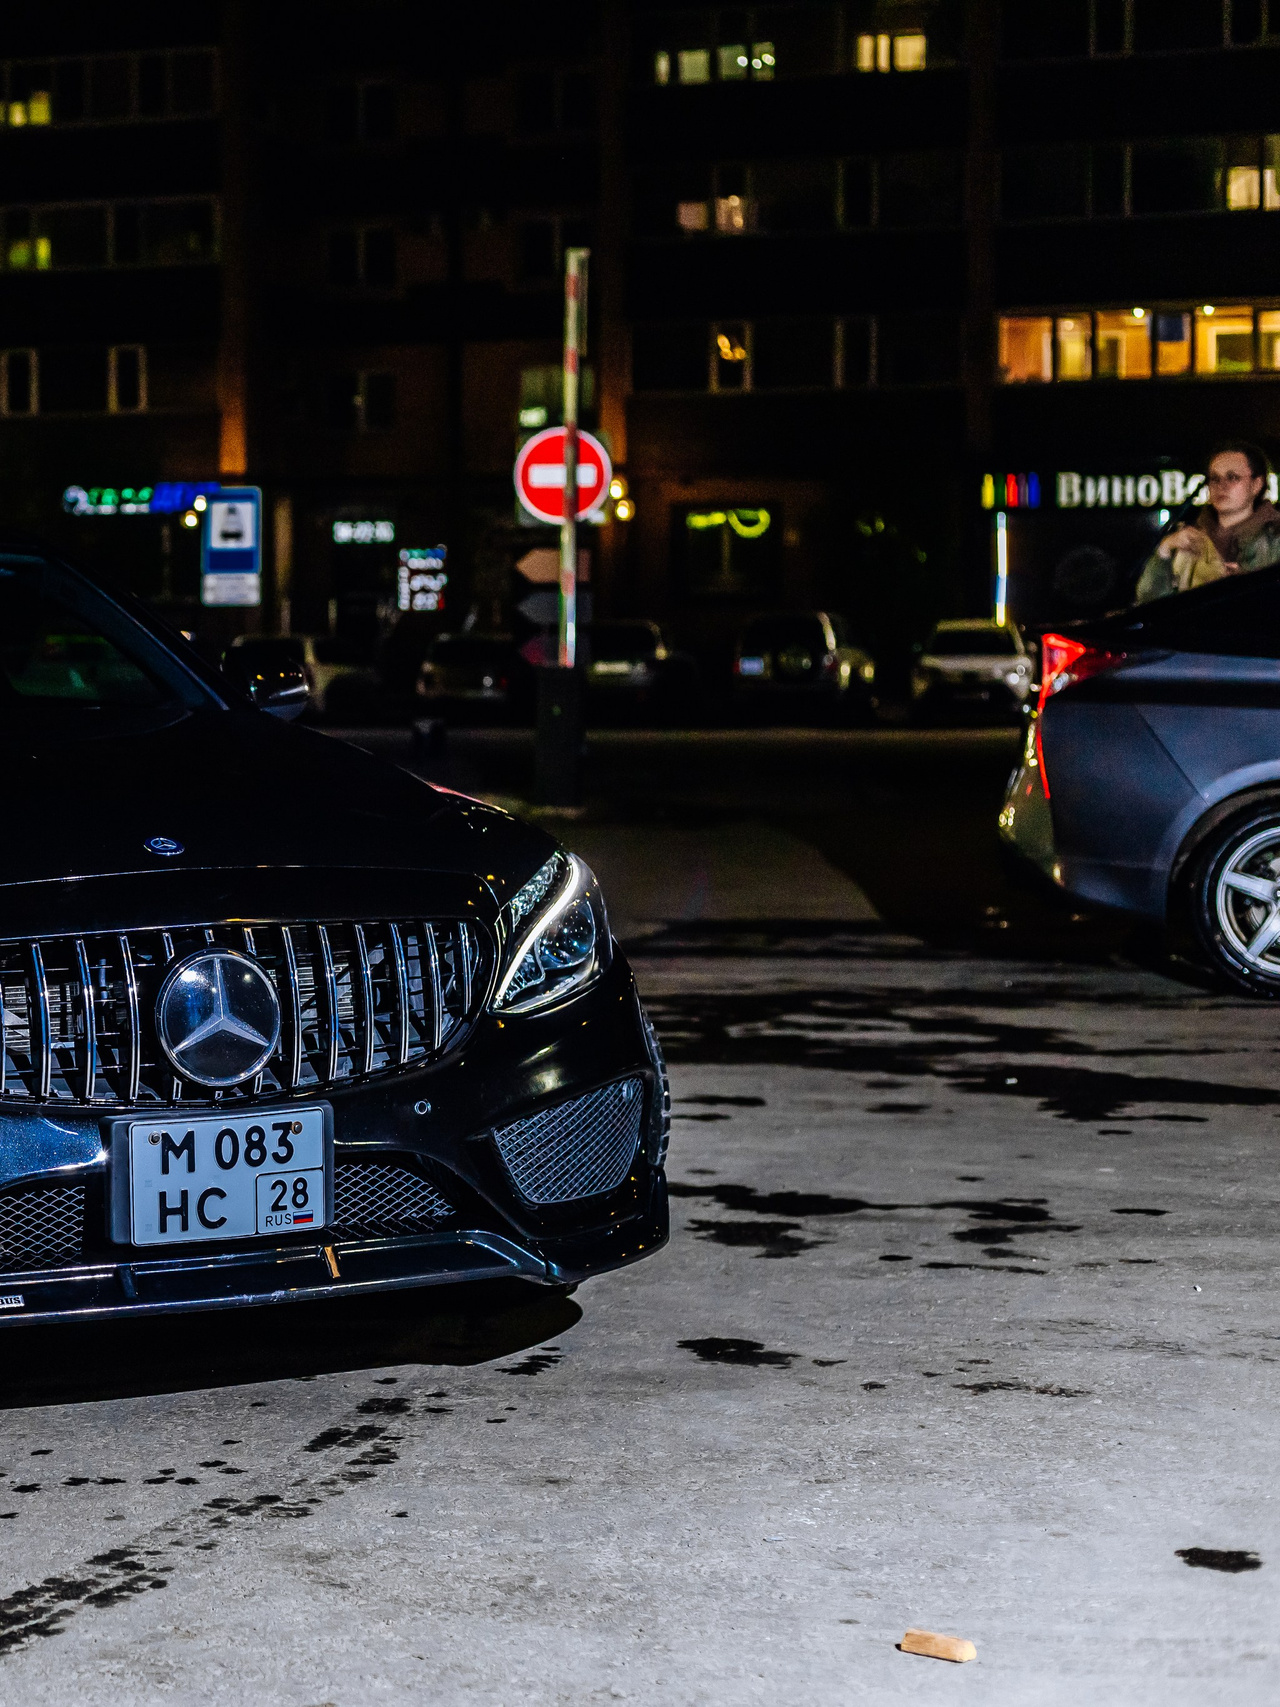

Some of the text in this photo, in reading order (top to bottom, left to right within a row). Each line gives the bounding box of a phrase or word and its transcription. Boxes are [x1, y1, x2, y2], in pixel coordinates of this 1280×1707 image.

[215, 1121, 294, 1170] 083
[270, 1177, 309, 1212] 28
[265, 1213, 292, 1227] RUS
